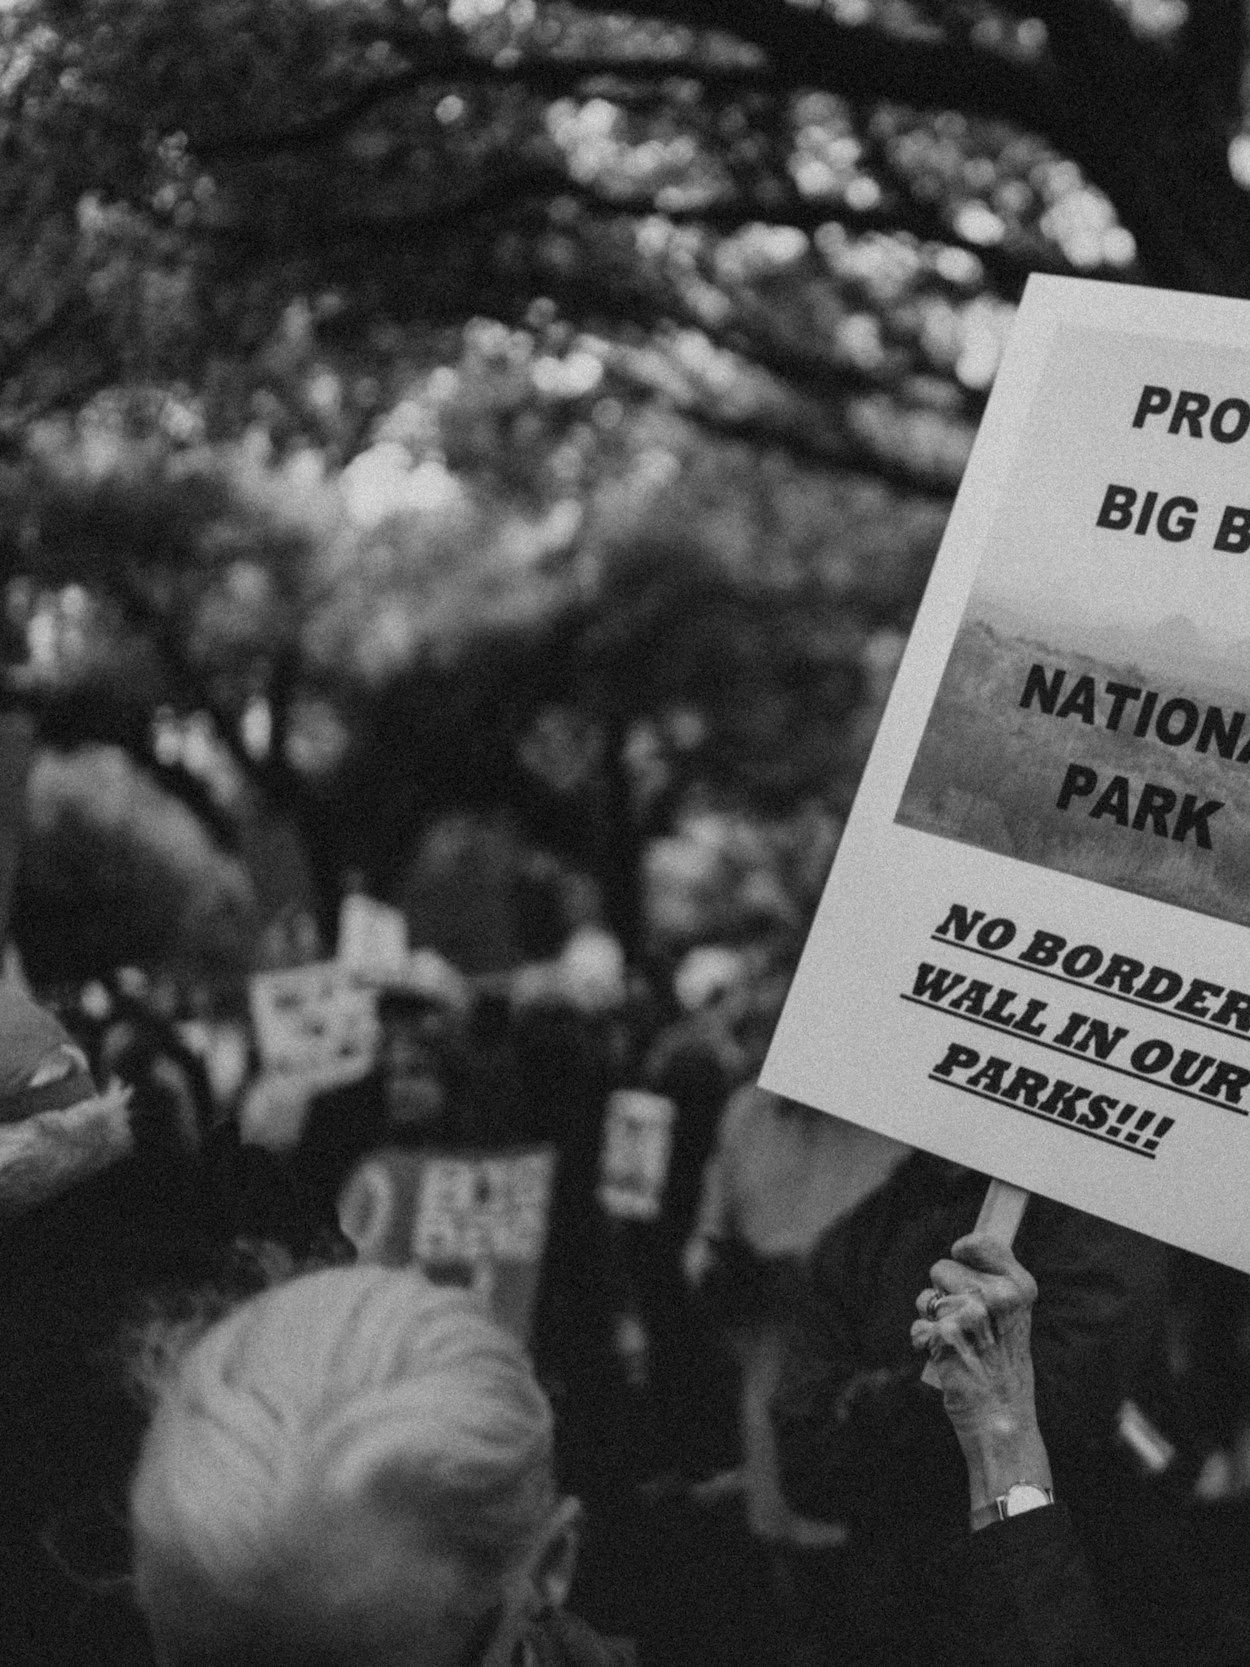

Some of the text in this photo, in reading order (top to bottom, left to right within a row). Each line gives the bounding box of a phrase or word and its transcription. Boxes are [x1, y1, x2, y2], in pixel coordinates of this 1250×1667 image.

[1096, 483, 1199, 543] BIG
[1056, 763, 1225, 850] PARK
[934, 903, 1017, 951] NO
[911, 961, 1049, 1037] WALL
[1052, 1012, 1130, 1060] IN
[932, 1042, 1175, 1151] PARKS!!!
